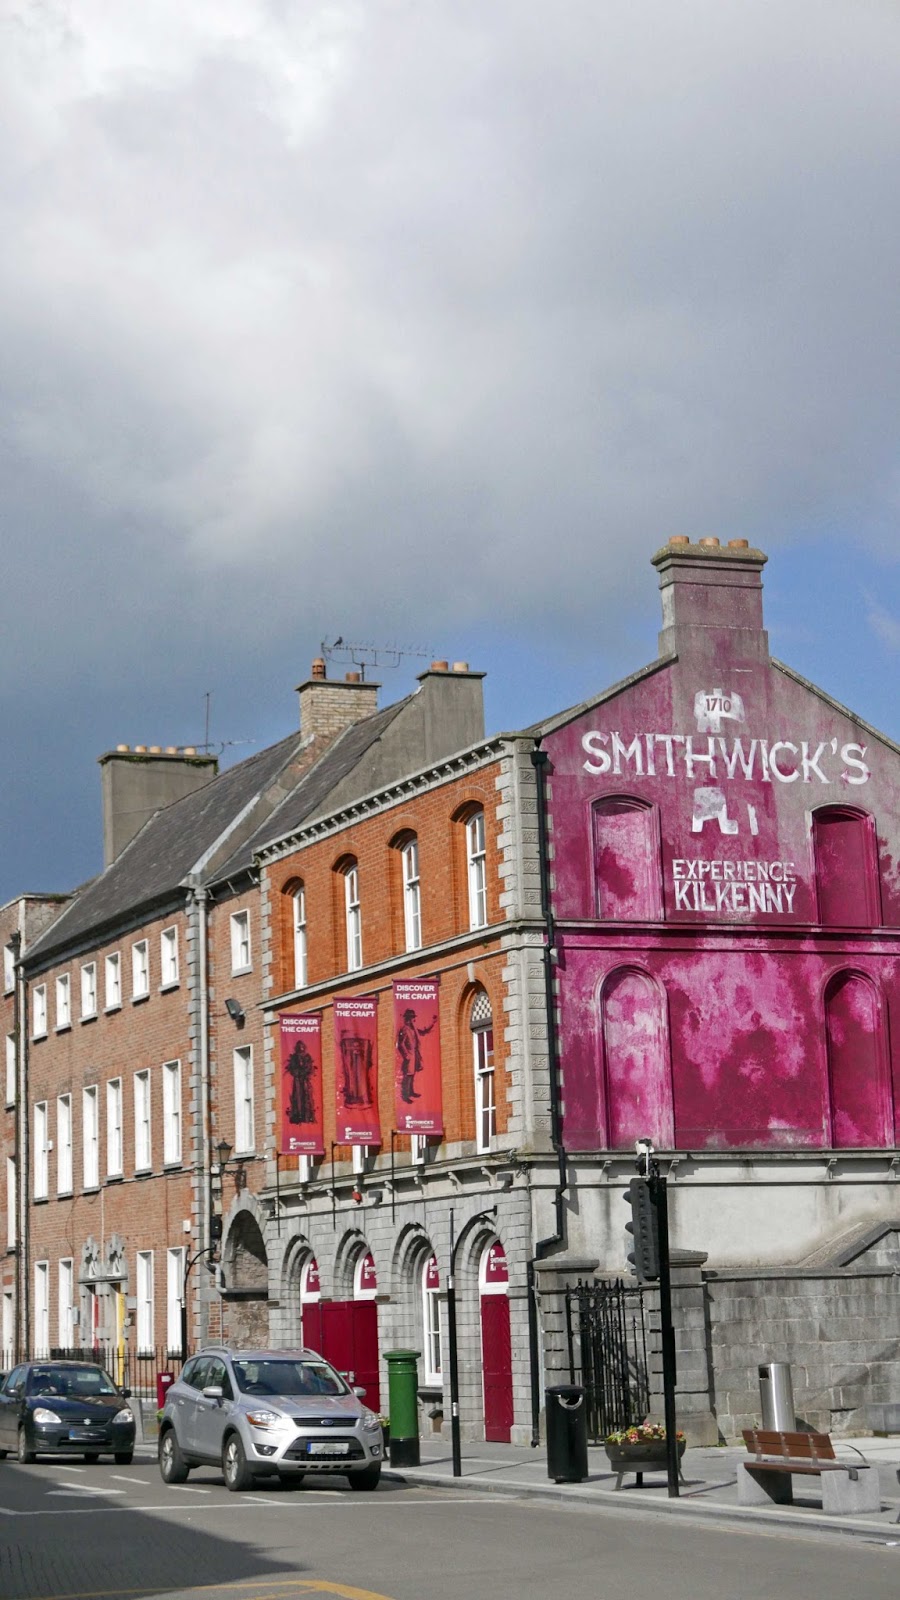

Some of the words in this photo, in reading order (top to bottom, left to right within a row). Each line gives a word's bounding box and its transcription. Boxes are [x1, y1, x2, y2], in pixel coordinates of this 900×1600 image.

[705, 697, 732, 713] 1710
[581, 730, 871, 785] SMITHWICK'S
[672, 859, 796, 882] EXPERIENCE
[673, 880, 797, 914] KILKENNY
